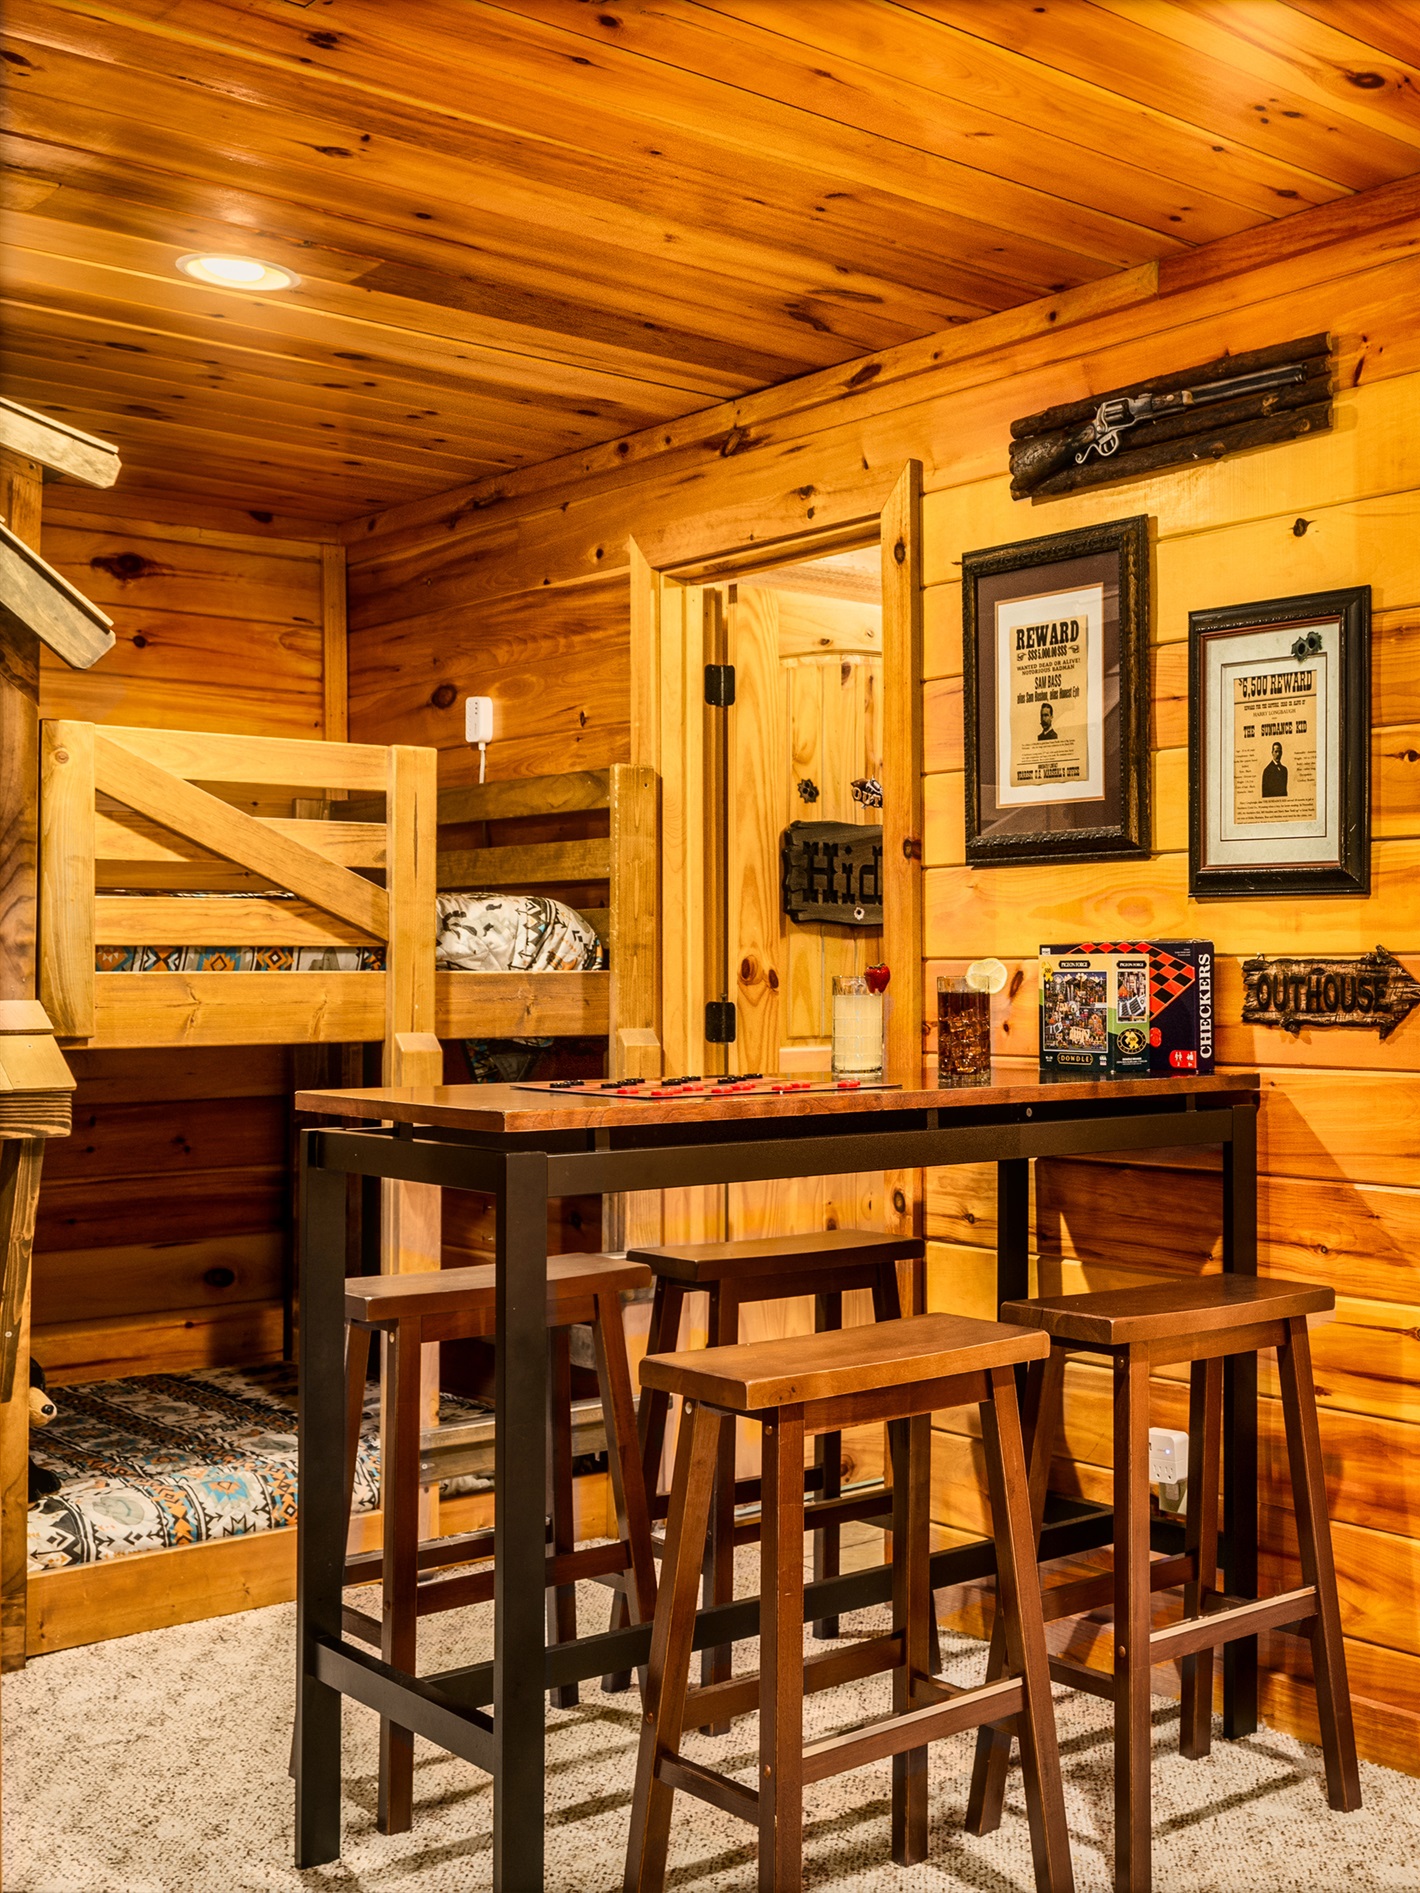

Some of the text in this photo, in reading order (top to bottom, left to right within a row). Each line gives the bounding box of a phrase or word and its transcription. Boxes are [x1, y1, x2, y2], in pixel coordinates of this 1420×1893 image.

[1016, 620, 1080, 651] REWARD
[1016, 663, 1038, 671] WANTED
[1062, 657, 1081, 665] ALIVE!
[1021, 664, 1075, 676] NOTORIOUS BADMAN
[1035, 673, 1062, 690] SAM BASS
[1238, 670, 1313, 700] $6,500 REWARD
[1253, 708, 1296, 718] HARRY LONGBAUGH
[1243, 720, 1308, 738] THE SUNDANCE KID
[852, 786, 884, 808] OUT
[802, 840, 884, 906] Hid
[1256, 973, 1392, 1013] OUTHOUSE
[1198, 953, 1213, 1059] CHECKERS
